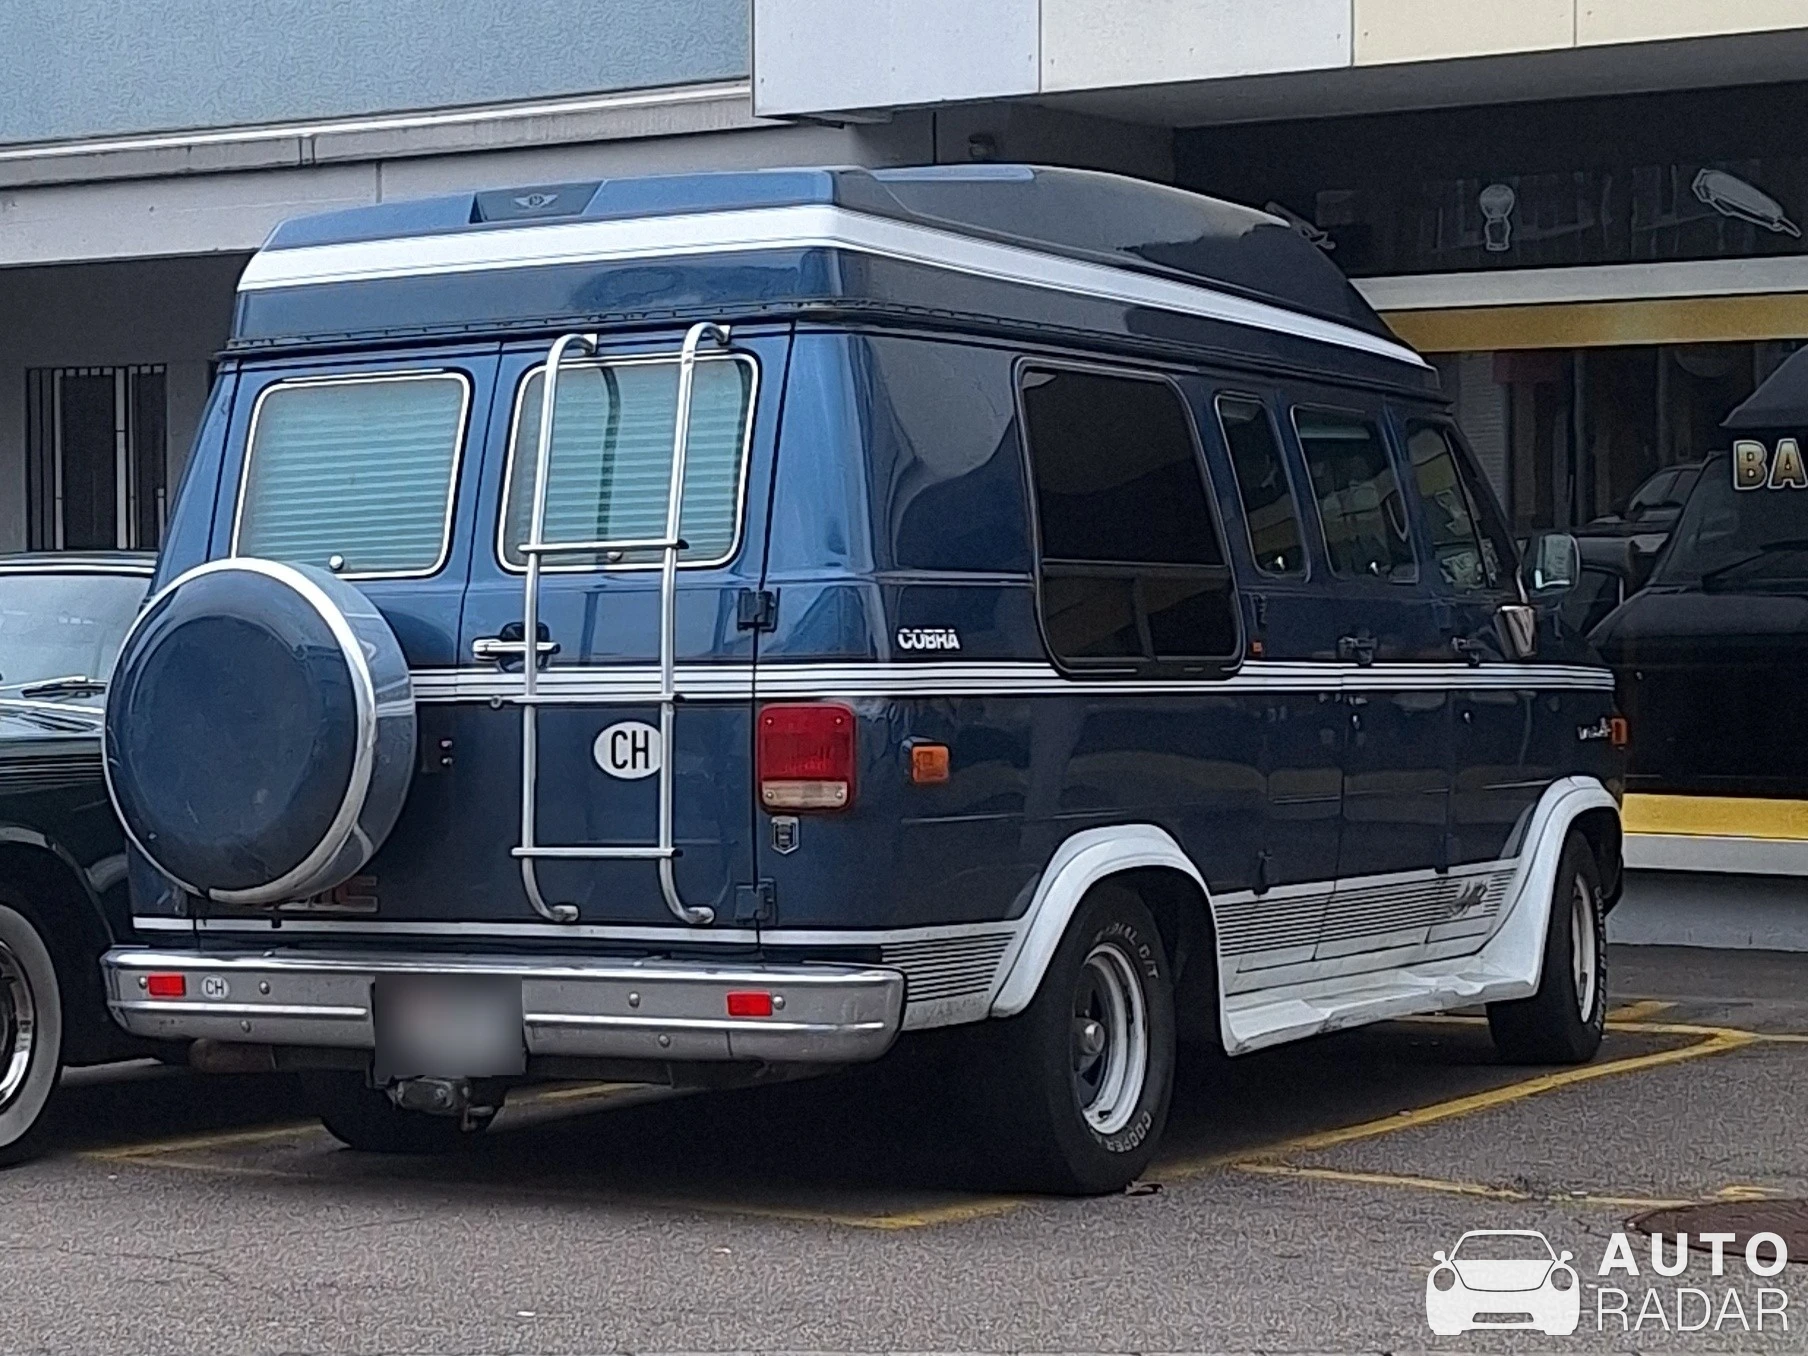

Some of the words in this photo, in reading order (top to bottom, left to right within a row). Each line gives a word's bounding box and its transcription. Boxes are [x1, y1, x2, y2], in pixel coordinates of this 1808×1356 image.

[1733, 438, 1808, 490] BA
[897, 628, 961, 649] COBRA
[611, 730, 649, 769] CH
[205, 979, 225, 996] CH
[1103, 1110, 1152, 1153] COOPER
